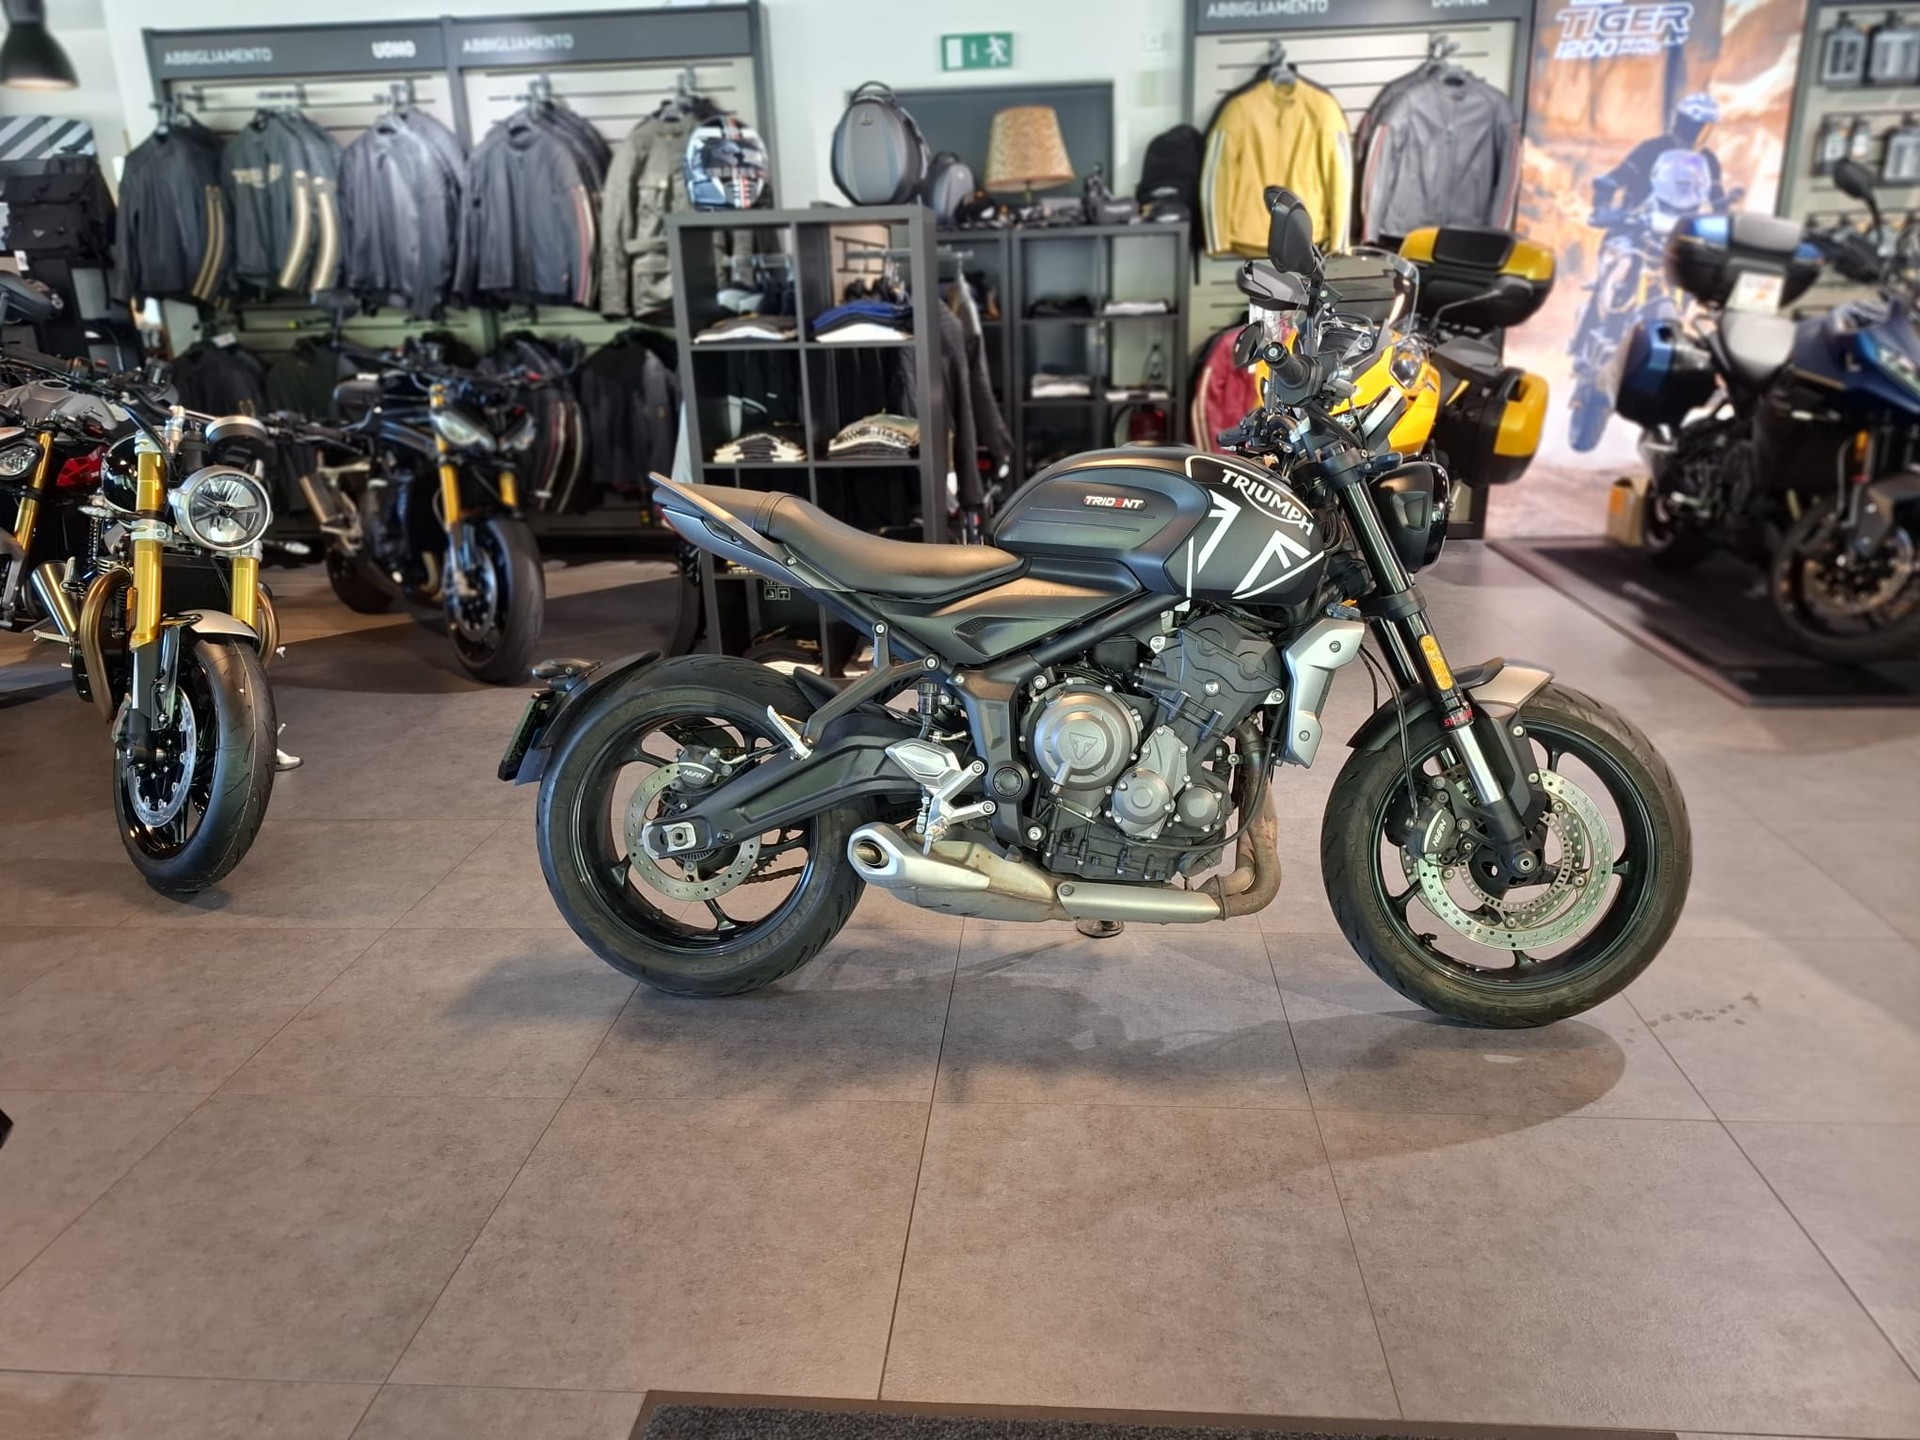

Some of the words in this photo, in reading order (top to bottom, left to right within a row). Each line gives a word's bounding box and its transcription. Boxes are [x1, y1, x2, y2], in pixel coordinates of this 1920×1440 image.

[1206, 0, 1329, 18] ABBIGLIAMENTO
[1555, 2, 1695, 40] TIGER
[164, 47, 273, 66] ABBIGLIAMENTO
[371, 40, 417, 59] UOMO
[462, 34, 574, 54] ABBIGLIAMENTO
[1553, 37, 1619, 60] 1200
[1084, 495, 1144, 510] TRIDENT
[1222, 468, 1315, 537] TRIUMPH
